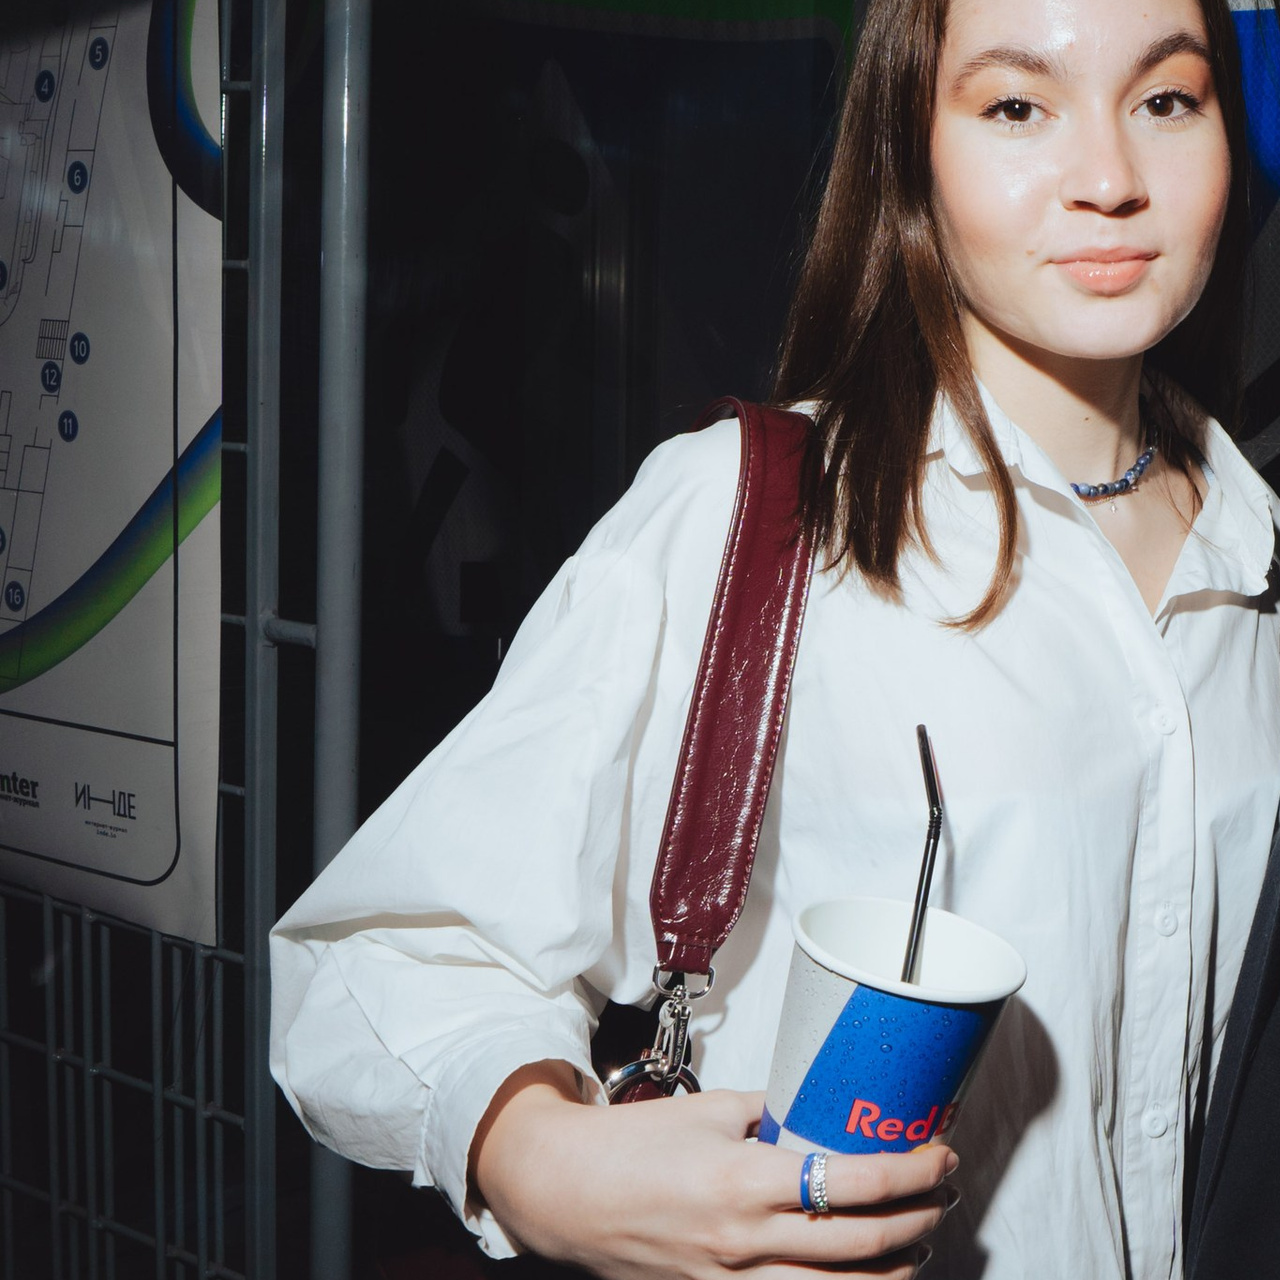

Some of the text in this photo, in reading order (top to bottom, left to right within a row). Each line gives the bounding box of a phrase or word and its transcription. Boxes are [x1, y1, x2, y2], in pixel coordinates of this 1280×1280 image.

[95, 45, 103, 62] 5
[41, 79, 49, 94] 4
[73, 169, 82, 186] 6
[73, 340, 87, 358] 10
[44, 368, 57, 386] 12
[63, 418, 73, 436] 11
[8, 588, 22, 606] 16
[0, 771, 39, 799] nter
[75, 782, 136, 820] ИНДЕ
[845, 1097, 940, 1142] Red
